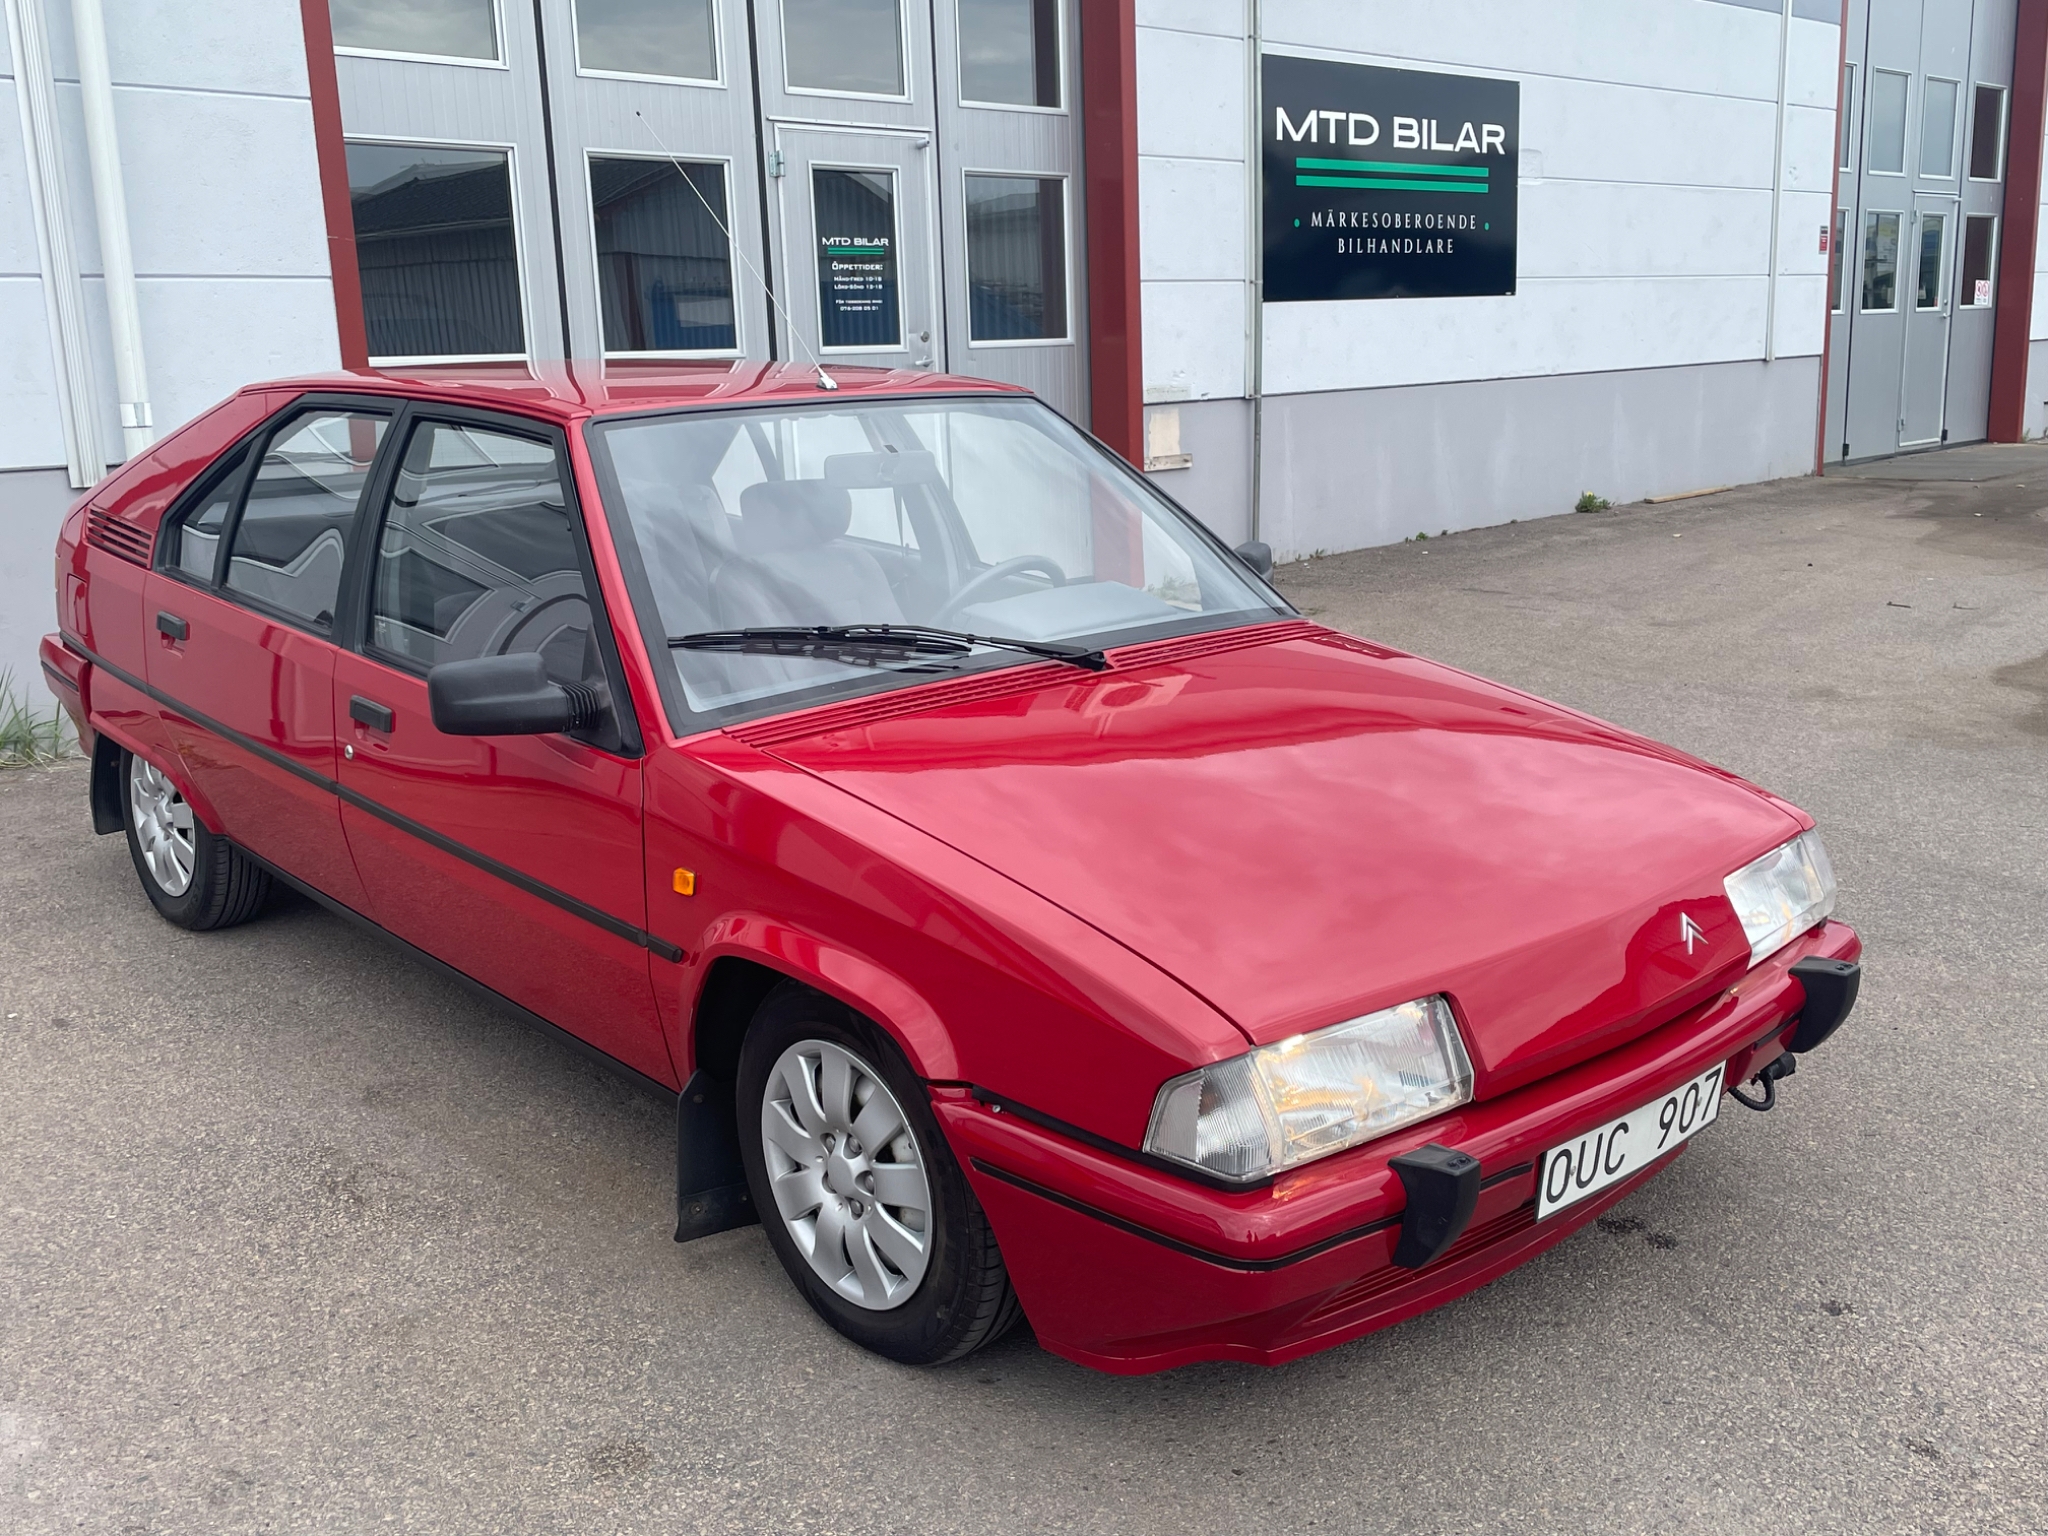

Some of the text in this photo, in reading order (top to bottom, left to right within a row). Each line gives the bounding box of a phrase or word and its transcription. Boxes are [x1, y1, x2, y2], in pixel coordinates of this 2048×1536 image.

[1276, 106, 1506, 155] MTD BILAR
[1310, 209, 1477, 230] MÄRKESOBEROENDE
[822, 237, 889, 246] MTD BILAR
[1337, 238, 1454, 254] BILHANDLARE
[1546, 1066, 1722, 1204] OUC 907
